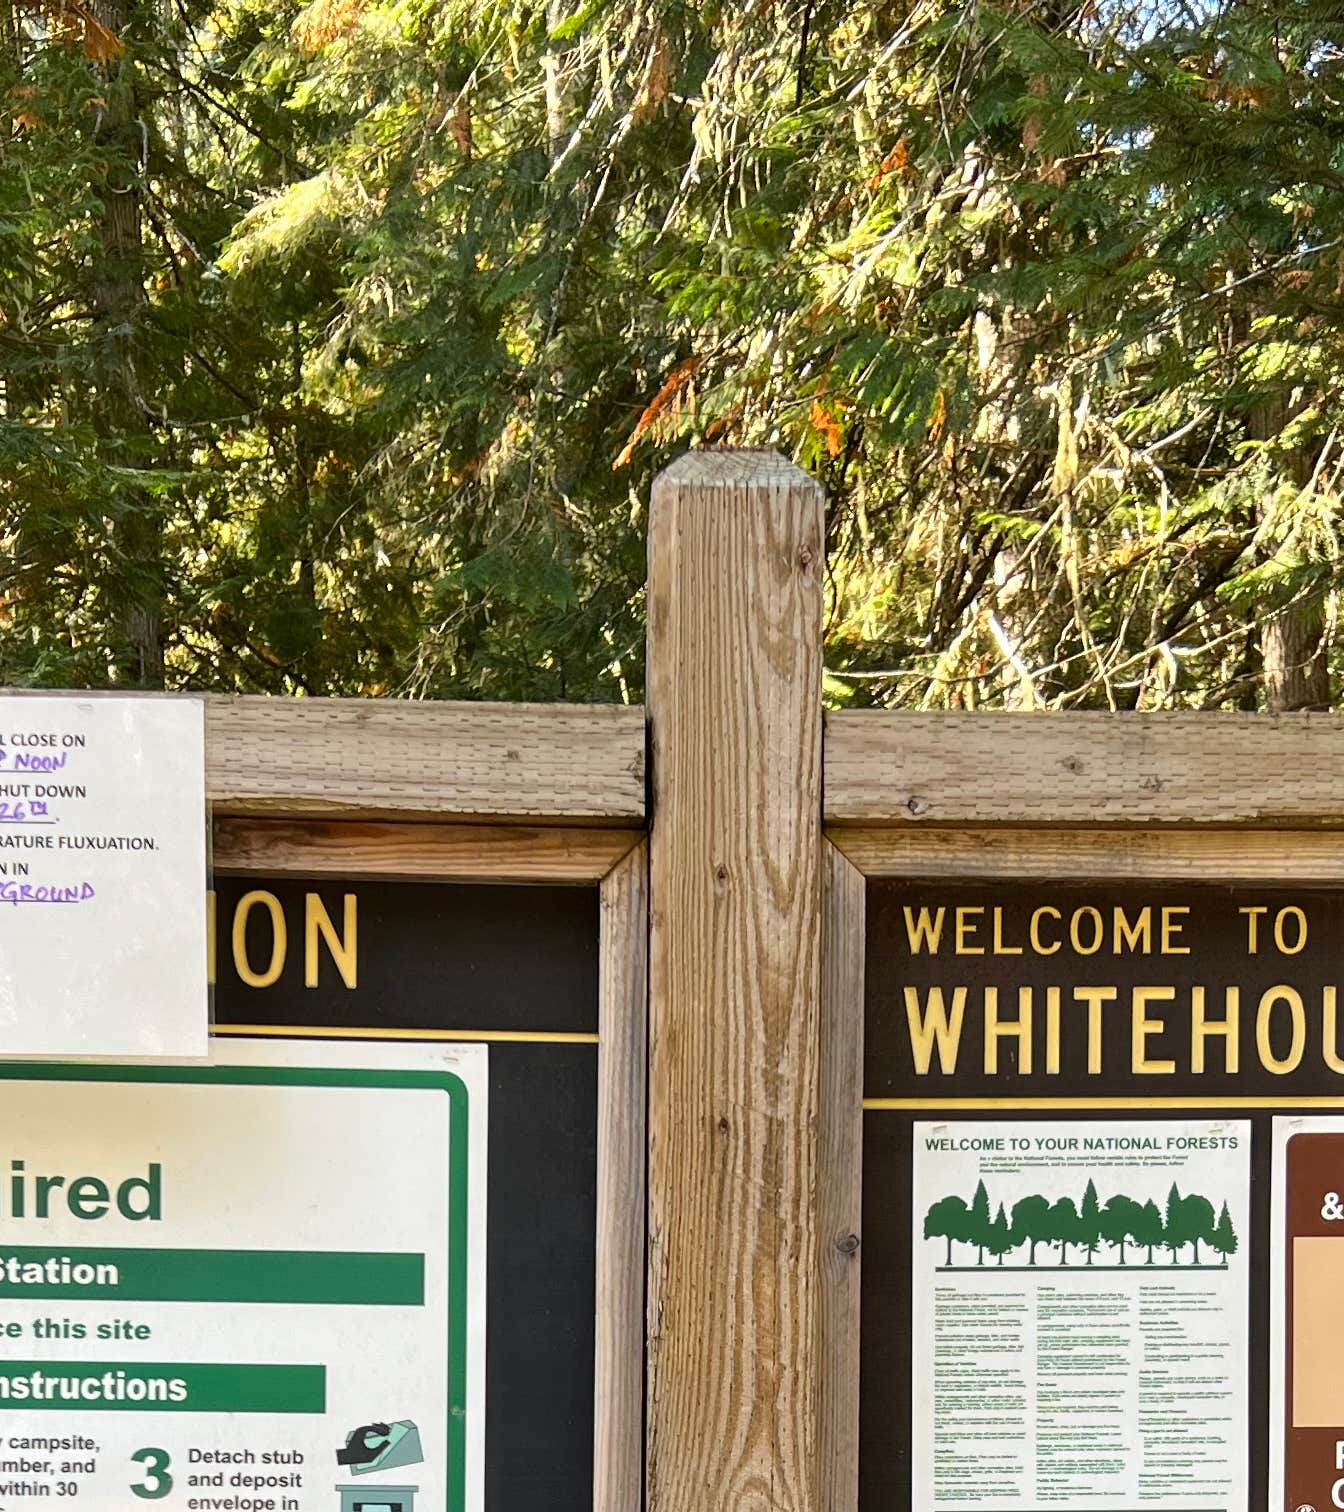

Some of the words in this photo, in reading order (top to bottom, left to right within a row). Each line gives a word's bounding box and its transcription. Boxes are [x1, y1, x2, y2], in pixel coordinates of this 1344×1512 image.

[10, 733, 58, 747] CLOSE
[61, 734, 86, 748] ON
[13, 753, 68, 772] NOON
[35, 784, 87, 799] DOWN
[58, 836, 160, 851] FLUXUATION.
[902, 905, 1191, 956] WELCOME
[1238, 905, 1308, 955] TO
[924, 1138, 1005, 1151] WELCOME
[1009, 1138, 1031, 1151] TO
[1034, 1137, 1079, 1151] YOUR
[1083, 1137, 1162, 1150] NATIONAL
[1166, 1136, 1239, 1150] FORESTS
[1320, 1191, 1344, 1221] &
[32, 1317, 87, 1340] this
[96, 1319, 152, 1341] site
[188, 1448, 255, 1465] Detach
[261, 1449, 305, 1465] stub
[129, 1447, 174, 1500] 3
[187, 1471, 224, 1487] and
[229, 1471, 303, 1491] deposit
[281, 1495, 299, 1511] in
